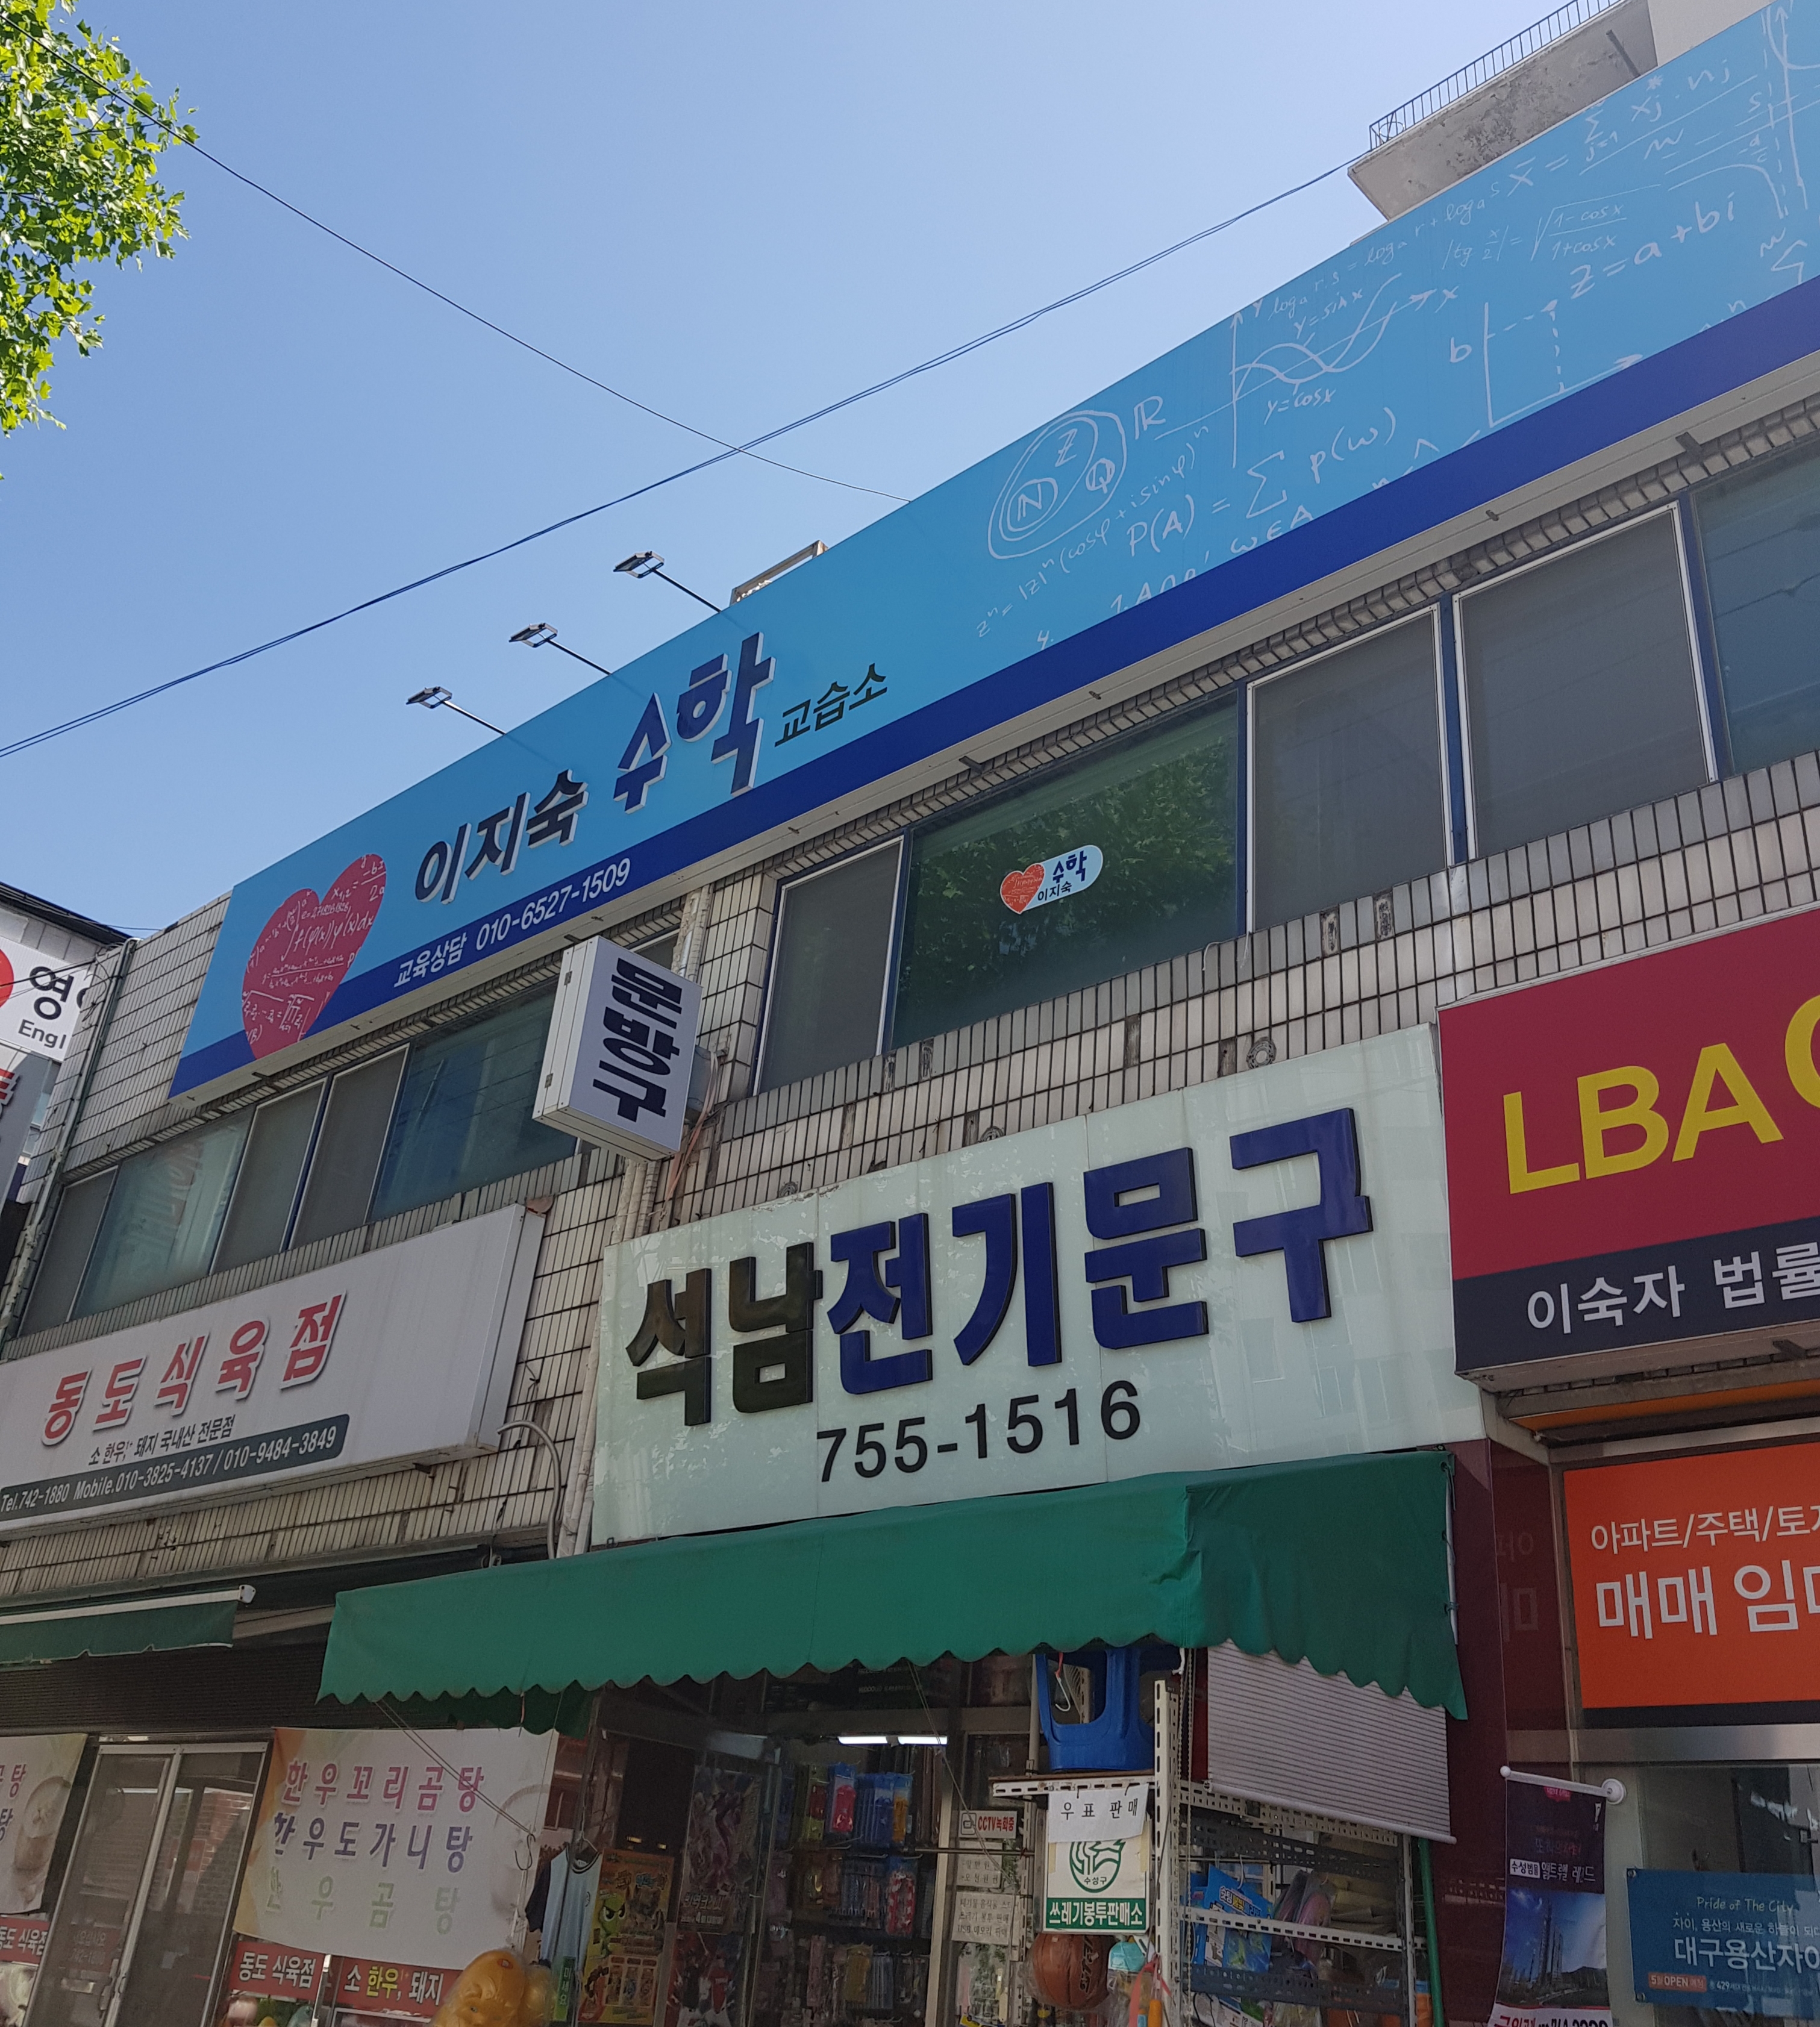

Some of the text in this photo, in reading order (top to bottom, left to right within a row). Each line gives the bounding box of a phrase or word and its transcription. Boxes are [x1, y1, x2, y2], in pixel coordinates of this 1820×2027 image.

[414, 632, 888, 905] 이지숙 수학 교습소
[1052, 851, 1087, 884] 수학
[1037, 881, 1072, 901] 이지숙
[393, 934, 468, 989] 교육상담
[475, 858, 632, 952] 010-6527-1509
[29, 966, 88, 1020] 영
[592, 957, 684, 1124] 문방구
[1527, 1241, 1820, 1334] 이숙자 법률
[134, 1432, 158, 1457] 돼지
[160, 1423, 196, 1452] 국내산
[197, 1415, 236, 1444] 전문점
[223, 1425, 337, 1471] 010-9484-3849
[816, 1379, 1142, 1482] 755-1516
[1596, 1566, 1718, 1639] 매매
[1060, 1798, 1138, 1820] 우표 판매
[1084, 1876, 1107, 1885] 수성구
[1049, 1901, 1143, 1927] 쓰레기봉투판매소
[1696, 1896, 1793, 1916] Pride of The City
[1701, 1917, 1731, 1933] 용산의
[1735, 1920, 1763, 1935] 새로운
[239, 1952, 269, 1982] 동도
[272, 1955, 316, 1988] 식육점
[344, 1964, 361, 1992] 소
[408, 1970, 444, 2006] 돼지
[1663, 1975, 1689, 1988] OPEN
